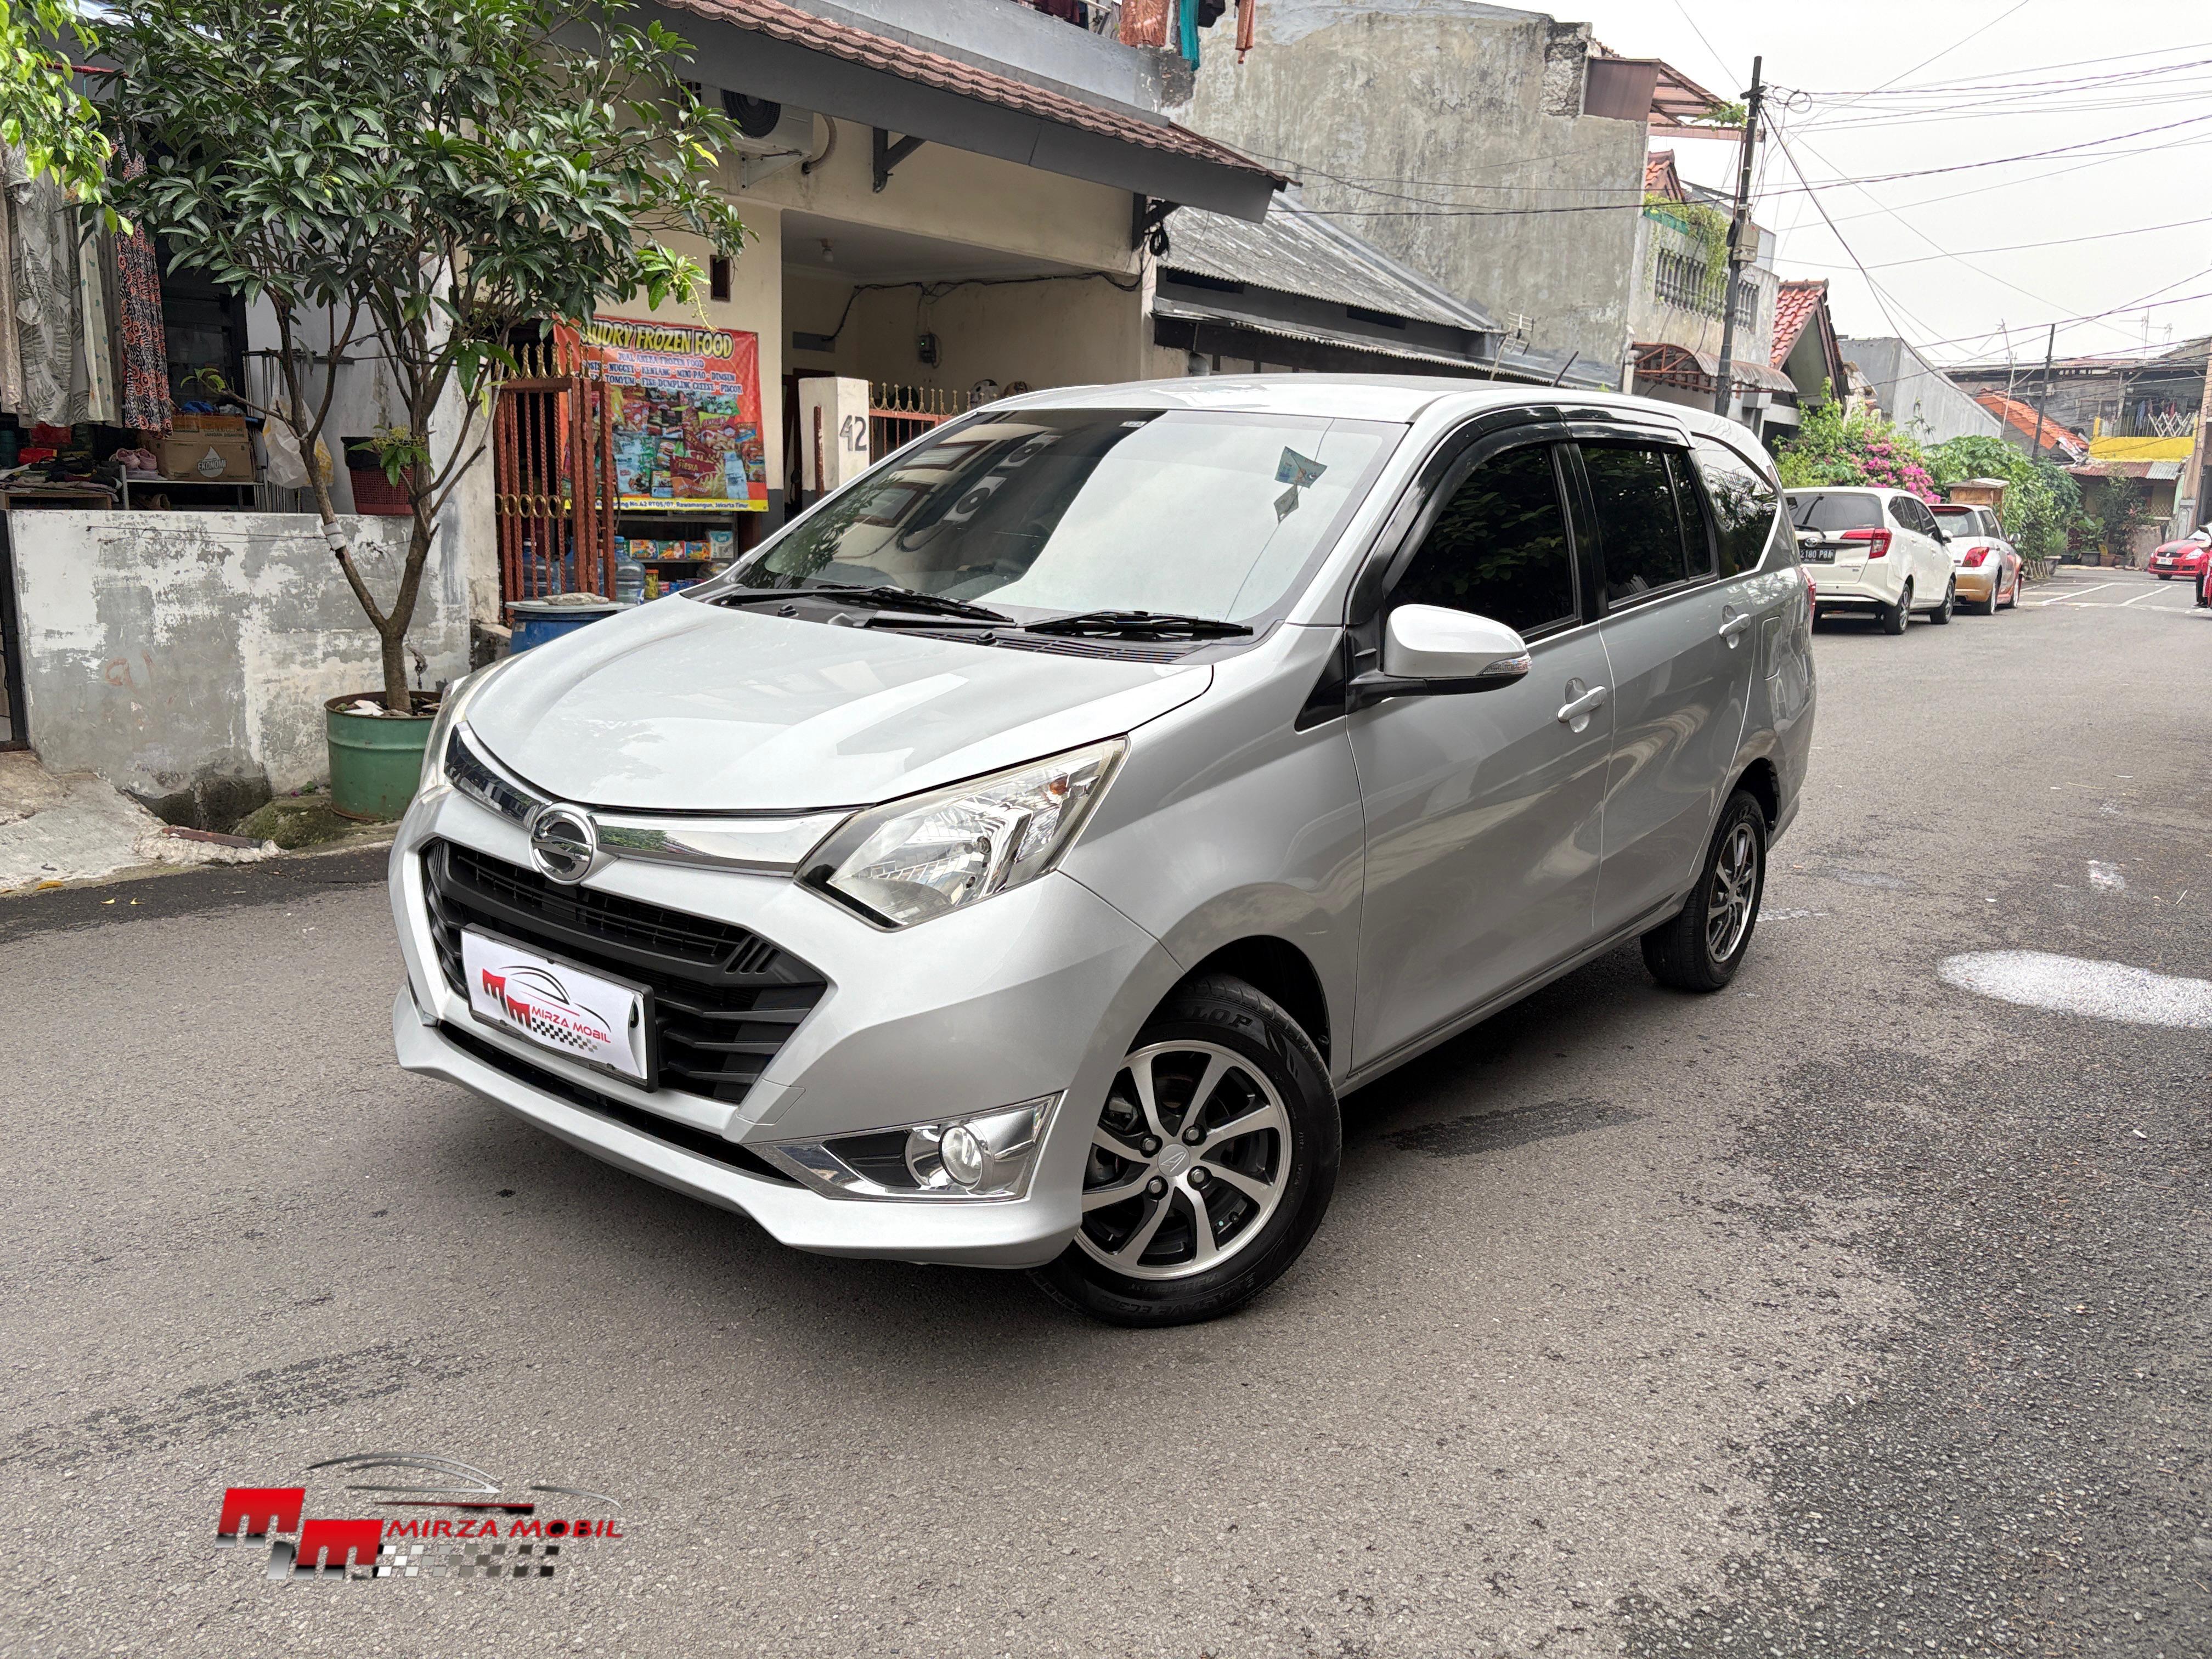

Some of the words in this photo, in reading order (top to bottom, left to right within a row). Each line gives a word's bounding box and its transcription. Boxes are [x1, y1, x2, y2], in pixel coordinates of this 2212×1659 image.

[636, 325, 691, 354] FROZEN
[694, 330, 733, 358] FOOD
[659, 356, 685, 366] FROZEN
[687, 359, 704, 368] FOOD
[608, 363, 634, 374] NUGGET
[693, 370, 706, 379] PAO
[605, 374, 635, 385] TOMYUM
[839, 415, 867, 452] 42
[198, 459, 227, 471] EKONOMI
[531, 1006, 569, 1028] MIRZA
[573, 1022, 611, 1044] MOBIL
